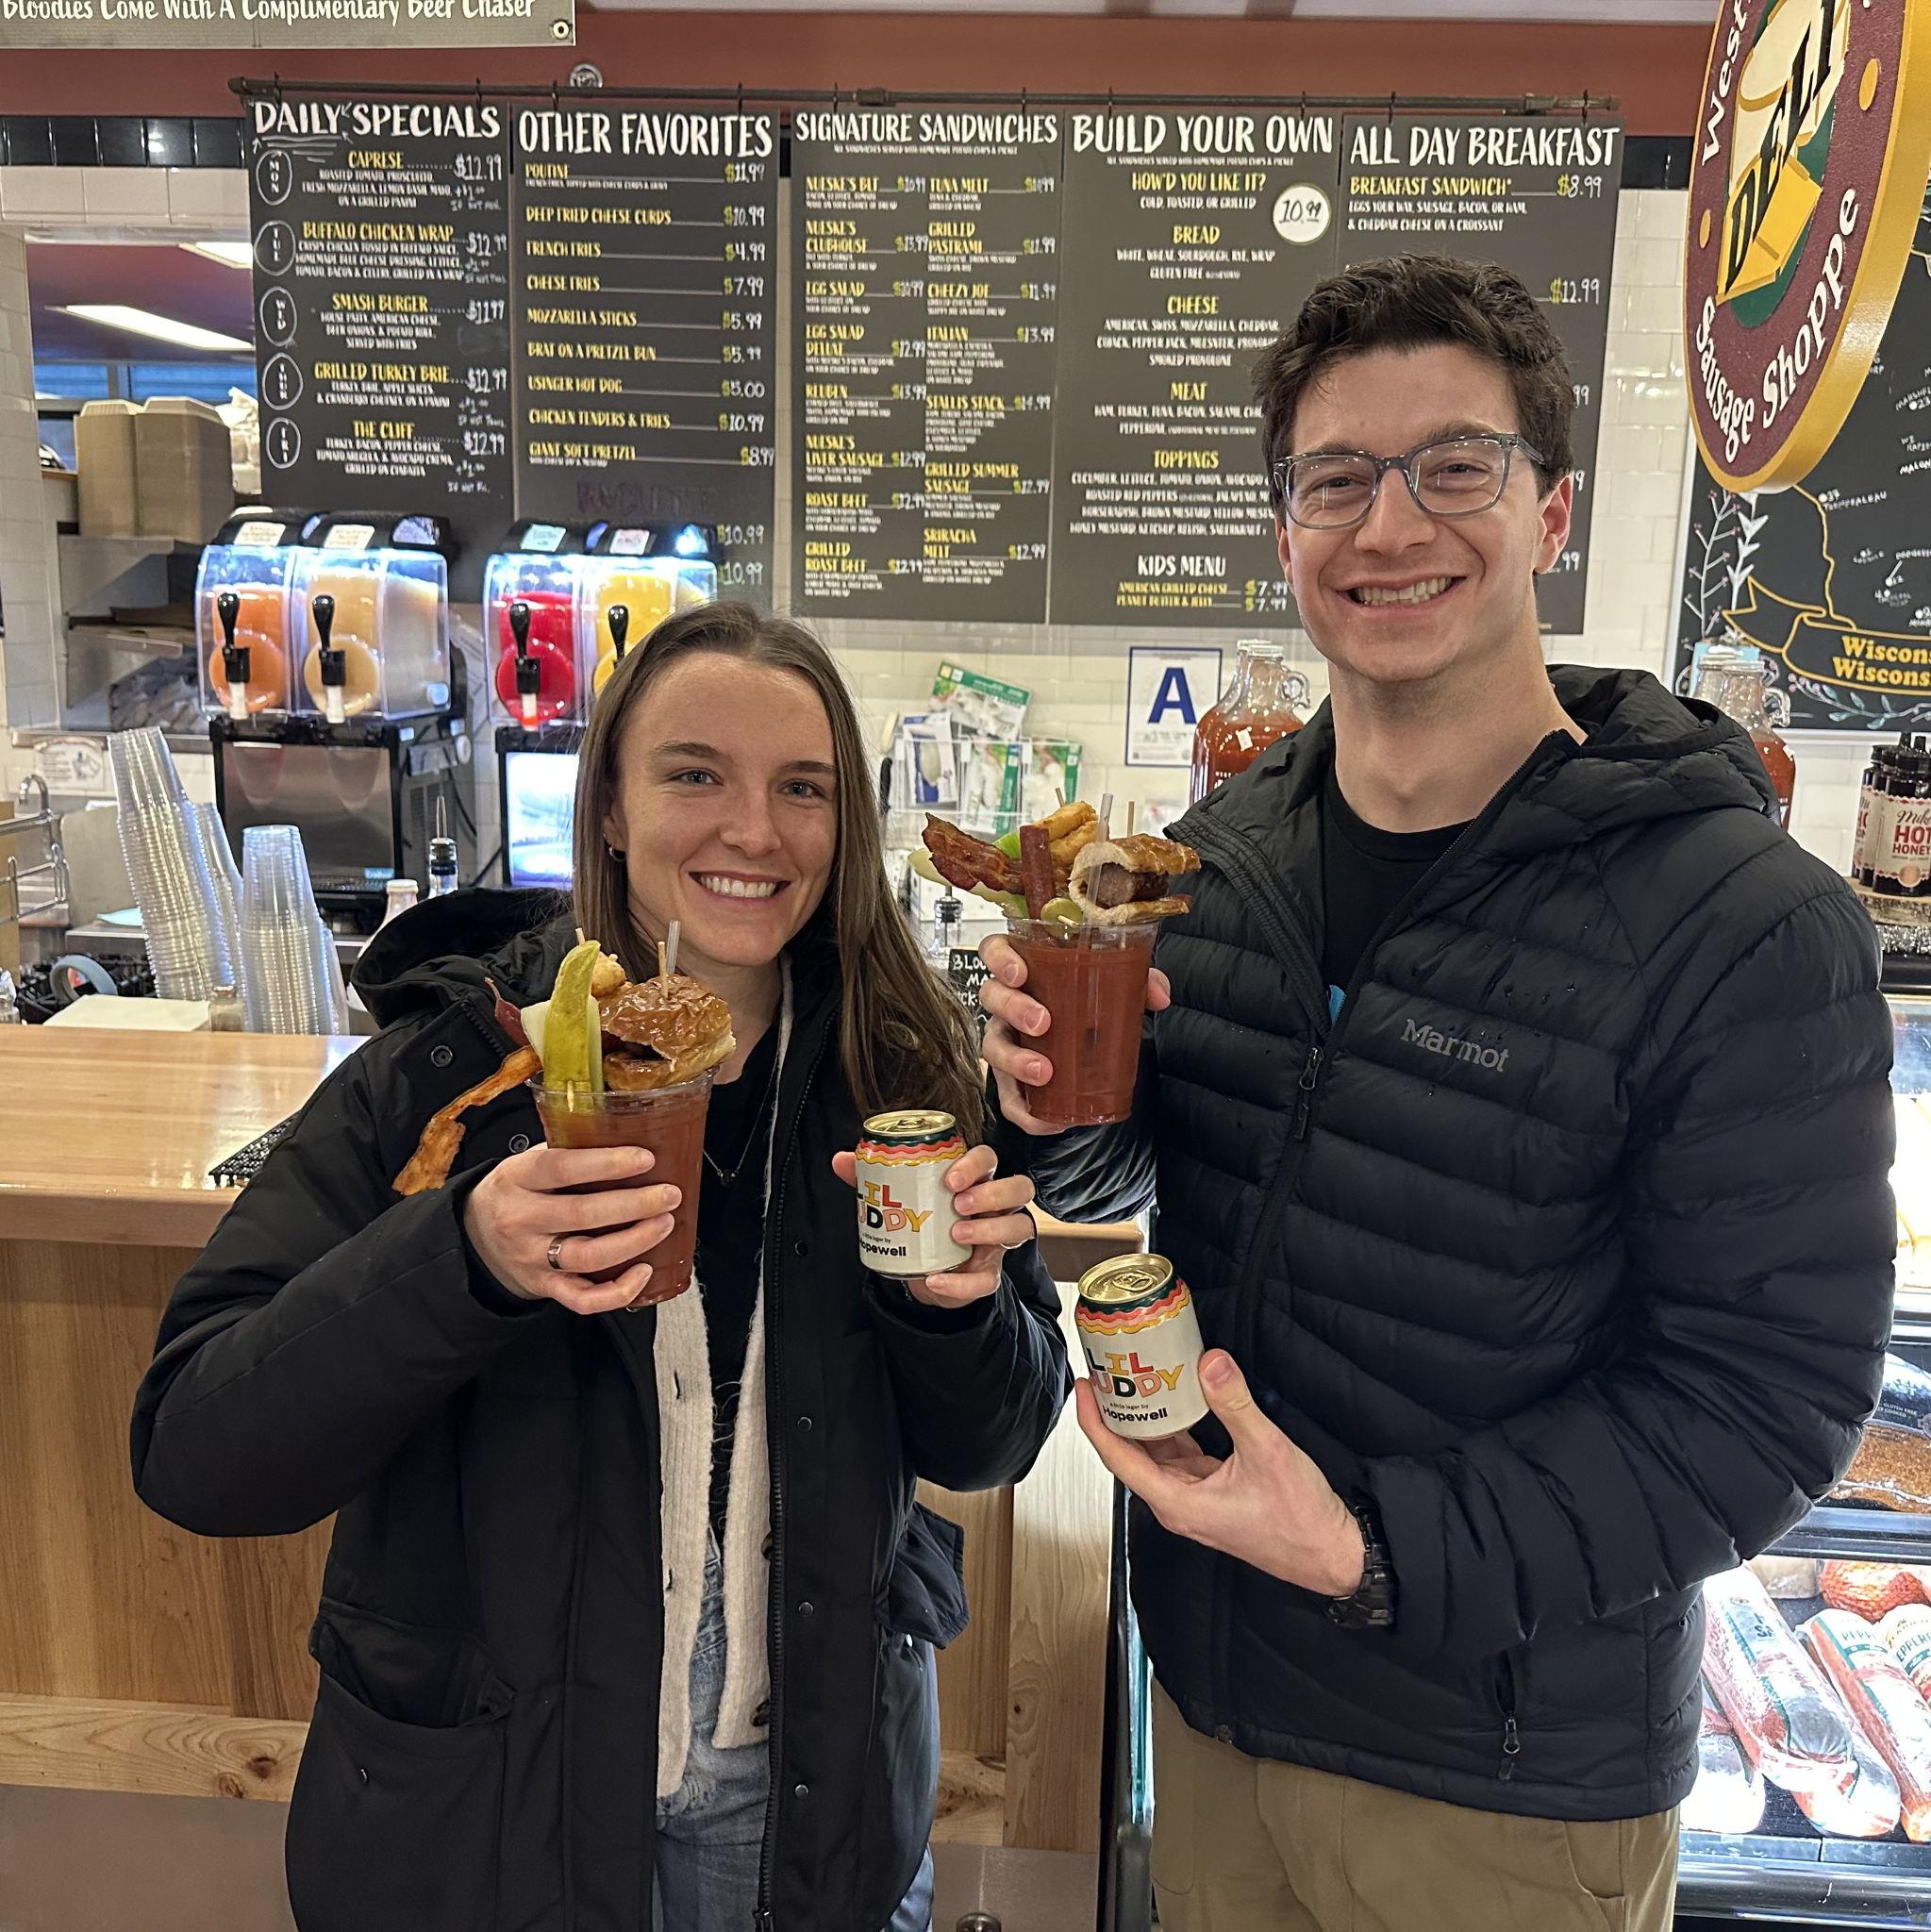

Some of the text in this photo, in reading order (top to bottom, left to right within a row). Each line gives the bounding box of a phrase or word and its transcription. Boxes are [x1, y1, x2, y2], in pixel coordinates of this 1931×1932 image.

[2, 0, 93, 20] Bloodies
[101, 0, 158, 20] Come
[219, 0, 236, 19] A
[408, 0, 455, 19] Beer
[255, 102, 501, 138] DAILY SPECIALS
[796, 113, 1058, 143] SIGNATURE SANDWICHES
[519, 111, 774, 158] OTHER FAVORITES
[1072, 115, 1332, 153] BUILD YOUR OWN
[1350, 126, 1621, 168] ALL DAY BREAKFAST
[349, 152, 502, 181] CAPRESE $12.99
[526, 163, 765, 183] POUTINE $11.99
[1132, 173, 1266, 192] HOW'D YOU LIKE IT?
[1349, 175, 1429, 196] BREAKFAST
[1557, 174, 1602, 199] $8.99
[526, 206, 765, 226] DEEP FRIED CHEESE CURDS $10.99
[1278, 200, 1321, 223] 10.99
[1349, 200, 1371, 213] EGGS
[1373, 201, 1393, 213] YOUR
[1491, 202, 1504, 213] OR
[928, 223, 975, 237] GRILLED
[1173, 225, 1220, 244] BREAD
[1347, 219, 1356, 230] &
[1400, 219, 1432, 231] CHEESE
[1434, 219, 1447, 231] ON
[1448, 220, 1455, 232] A
[1457, 220, 1504, 232] CROISSANT
[303, 222, 508, 257] BUFFALO CHICKEN WRAP $12.99
[928, 240, 983, 255] PASTRAMI
[526, 241, 766, 262] FRENCH FRIES $4.99
[526, 275, 764, 297] CHEESE FRIES $7.99
[1550, 276, 1600, 306] $12.99
[332, 293, 428, 312] SMASH BURGER
[1167, 295, 1219, 315] CHEESE
[528, 308, 762, 330] MOZZARELLA STICKS $5.99
[1696, 189, 1859, 463] Sausage Shoppe
[806, 325, 864, 340] EGG SALAD
[926, 326, 1055, 343] ITALIAN $13.99
[528, 341, 762, 364] BRAT ON A PRETZEL BUN $5.99
[806, 341, 926, 358] DELUXE $12.99
[315, 362, 508, 393] GRILLED TURKEY BRIE $12.99
[528, 375, 766, 398] USINGER HOT DOG $5.00
[806, 385, 926, 400] REUBEN $13.99
[1171, 382, 1207, 401] MEAT
[528, 408, 764, 432] CHICKEN TENDERS & FRIES $10.99
[353, 421, 506, 456] THE CLIFF $12.99
[528, 441, 775, 466] GIANT SOFT PRETZEL $8.99
[806, 451, 926, 468] LIVER SAUSAGE $12.99
[1154, 450, 1219, 469] TOPPINGS
[924, 463, 1019, 477] GRILLED SUMMER
[924, 528, 977, 543] SRIRACHA
[806, 542, 850, 557] GRILLED
[924, 544, 1046, 559] MELT $12.99
[806, 558, 838, 573] ROAST
[841, 558, 868, 573] BEEF
[1138, 555, 1226, 577] KIDS MENU
[1841, 635, 1931, 664] Wiscon
[1832, 657, 1931, 687] Wiscons
[1147, 666, 1197, 724] A
[1894, 824, 1931, 845] HOT
[1892, 843, 1930, 856] HONEY
[1401, 1018, 1509, 1073] Marmot
[1087, 1347, 1155, 1375] LIL
[1102, 1406, 1168, 1423] Hopewell
